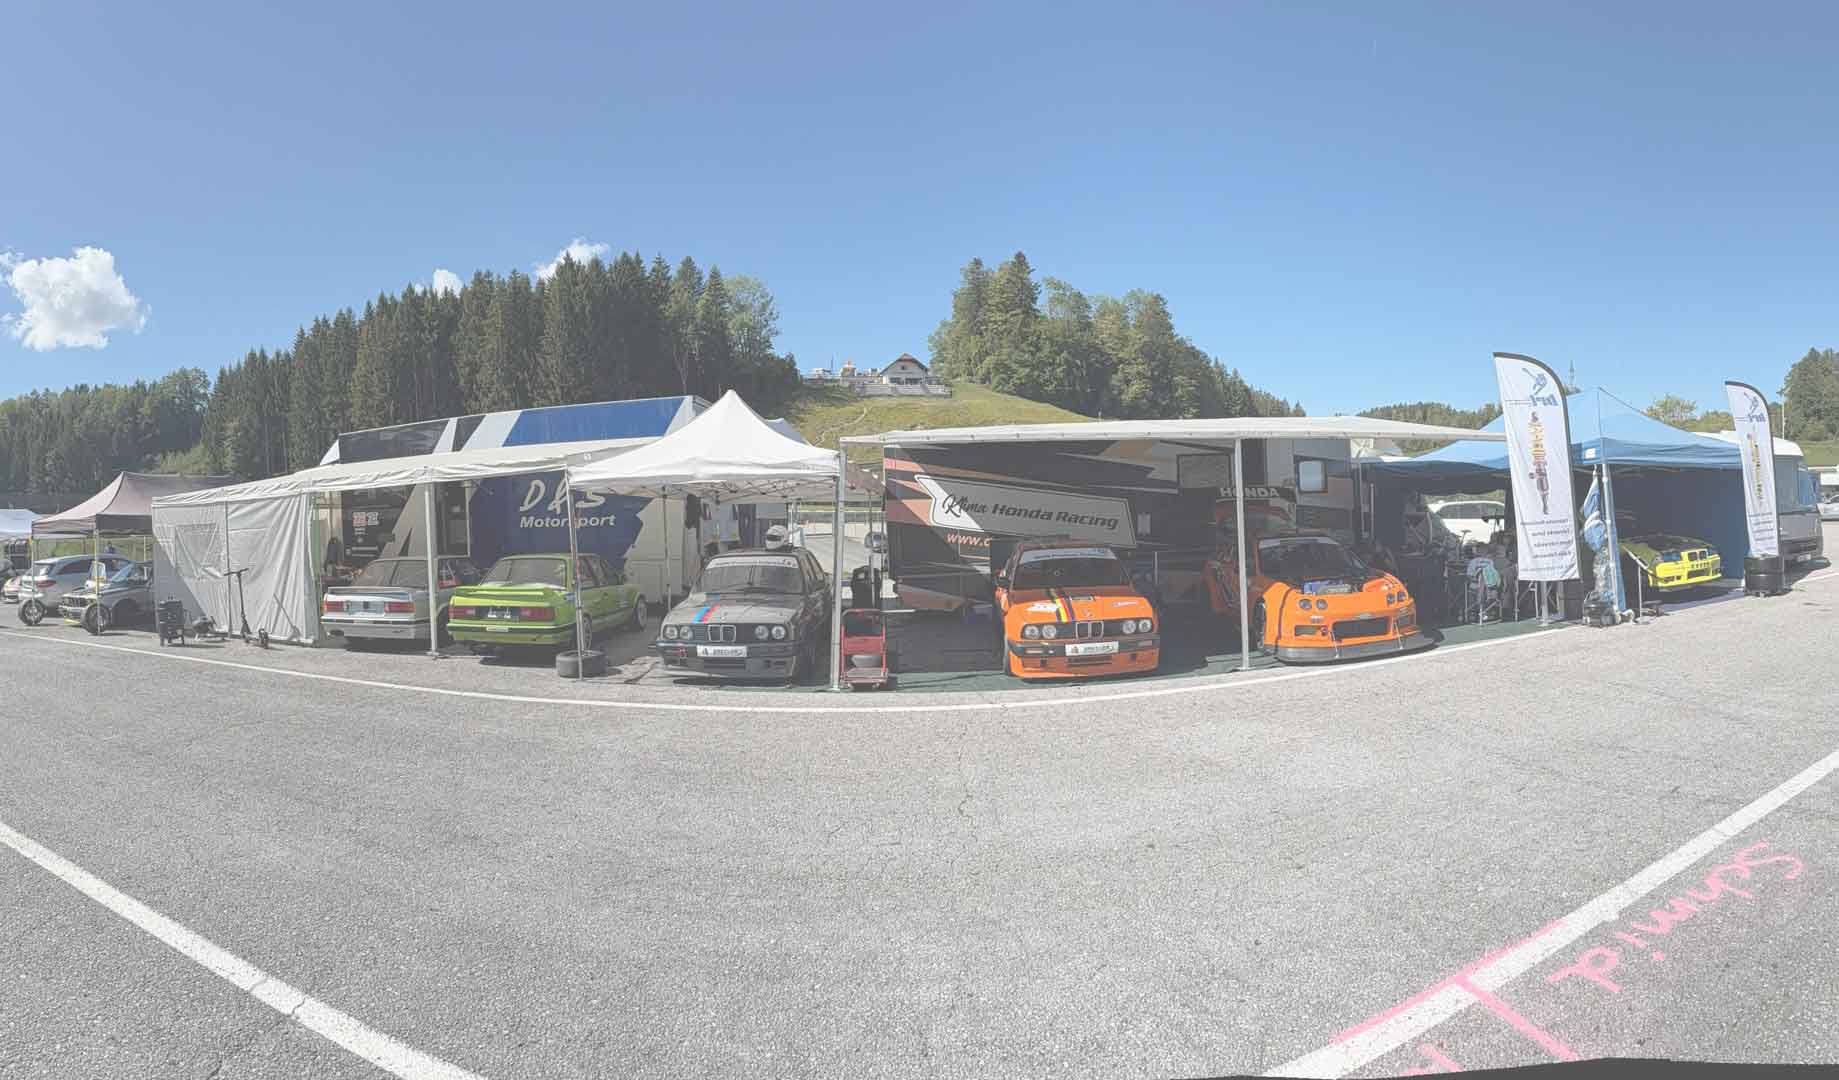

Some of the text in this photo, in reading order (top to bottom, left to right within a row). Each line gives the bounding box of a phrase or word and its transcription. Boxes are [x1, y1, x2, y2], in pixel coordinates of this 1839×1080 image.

[1219, 486, 1280, 498] HNDA
[519, 514, 617, 529] Motorport
[991, 503, 1054, 522] Honda
[1056, 511, 1120, 531] Racing
